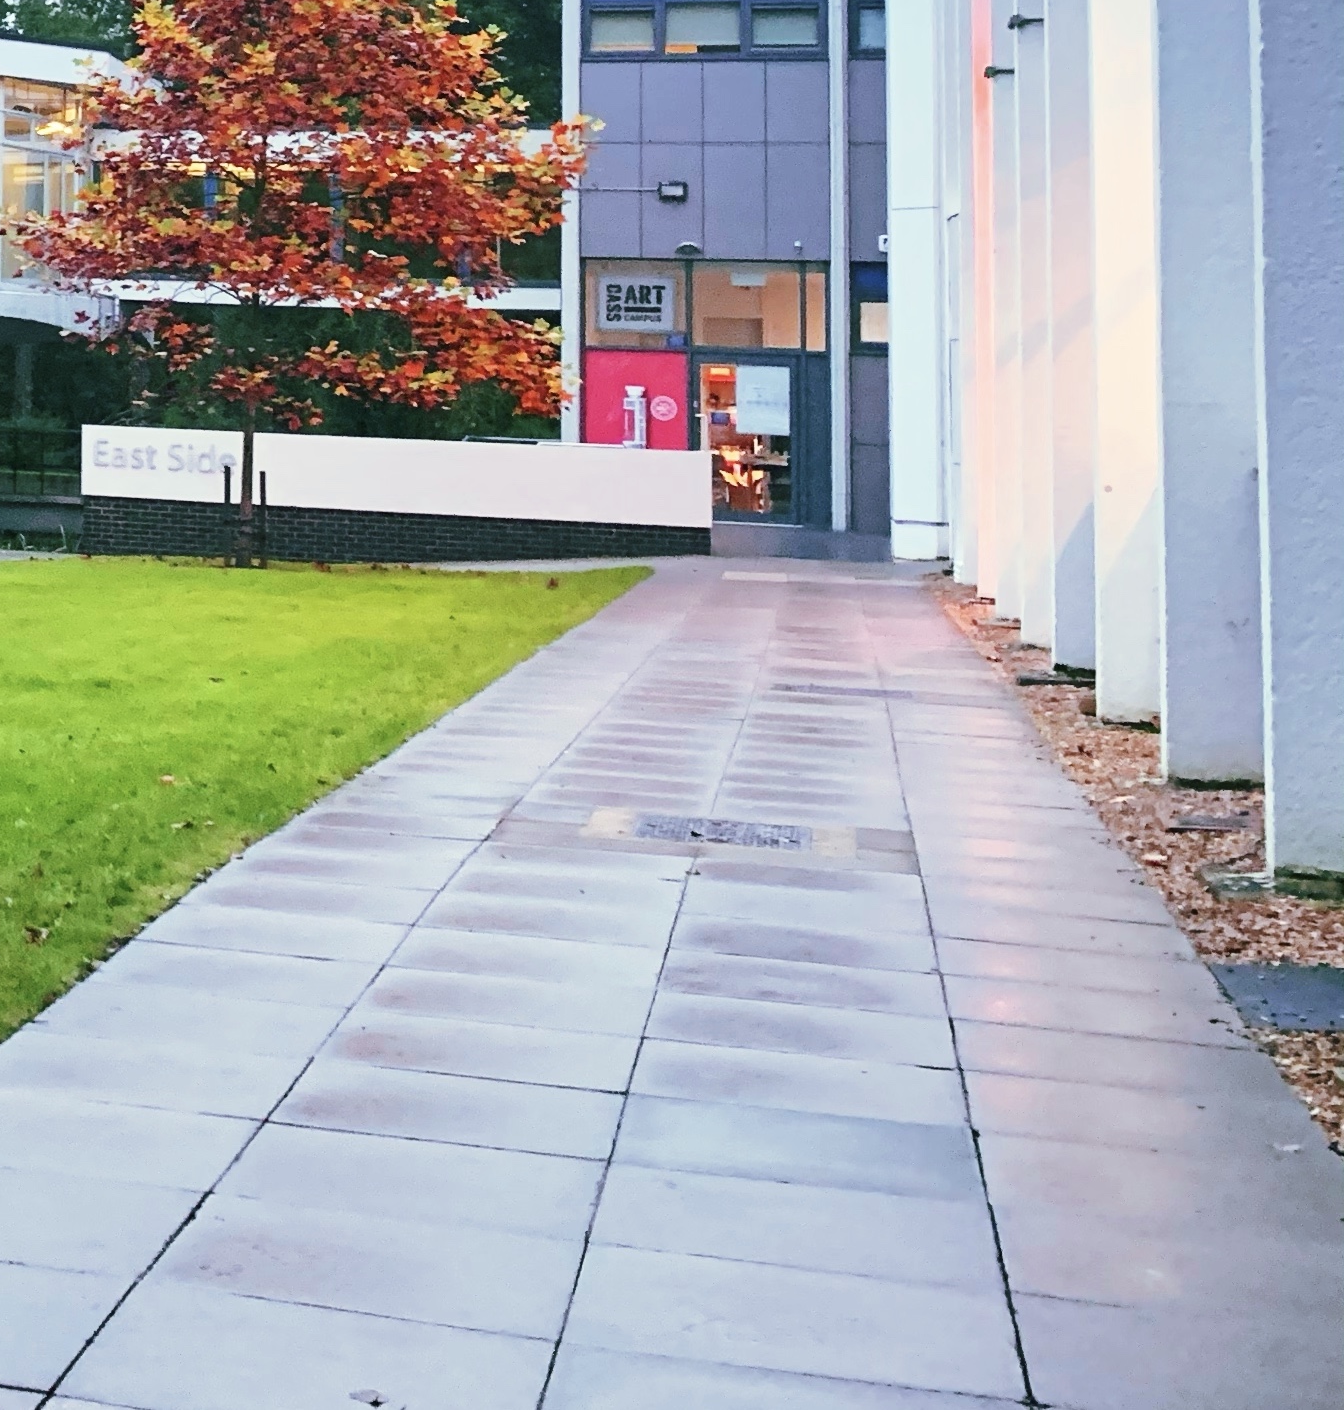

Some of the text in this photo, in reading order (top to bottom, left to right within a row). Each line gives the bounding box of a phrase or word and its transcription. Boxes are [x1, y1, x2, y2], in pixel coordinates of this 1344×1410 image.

[624, 285, 666, 304] ART
[93, 439, 237, 474] East Side
